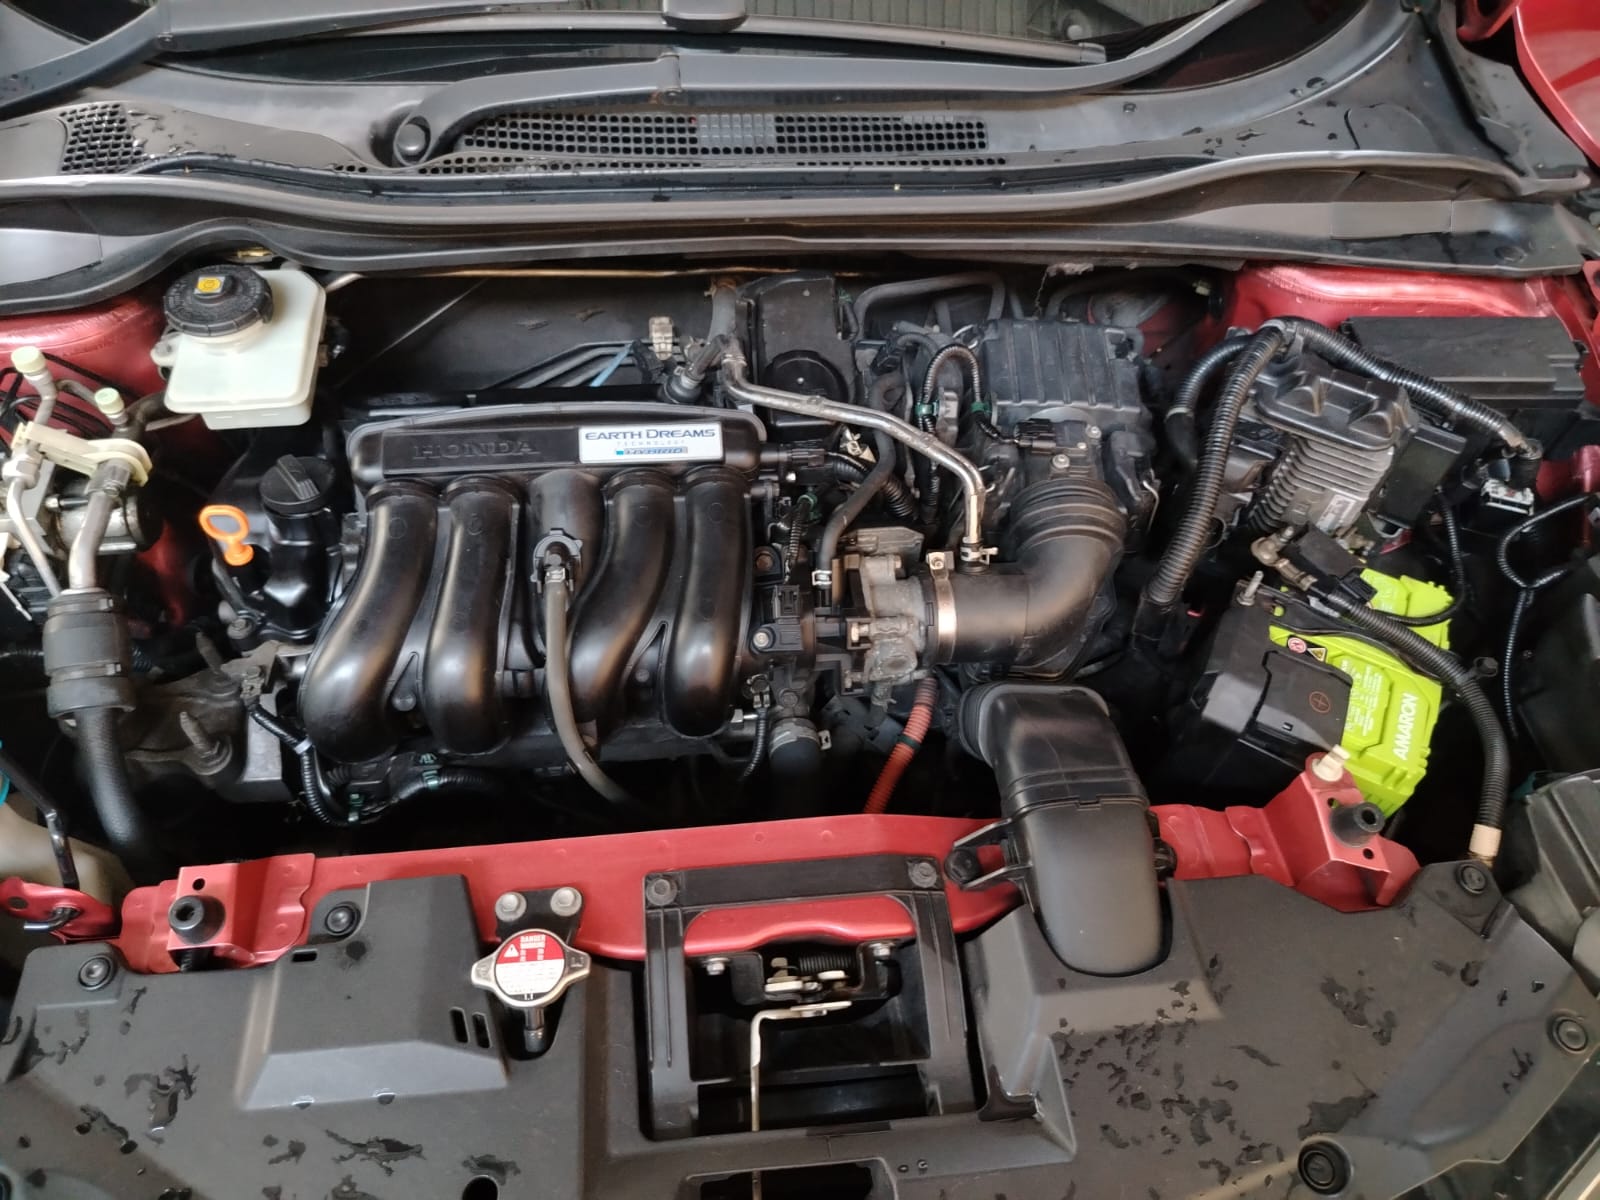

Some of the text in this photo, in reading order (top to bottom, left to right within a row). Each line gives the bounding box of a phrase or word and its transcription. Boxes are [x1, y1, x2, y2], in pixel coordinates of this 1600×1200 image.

[585, 429, 716, 441] EARTH DREAMS
[413, 440, 541, 460] HONDA
[1393, 692, 1418, 761] AMARON
